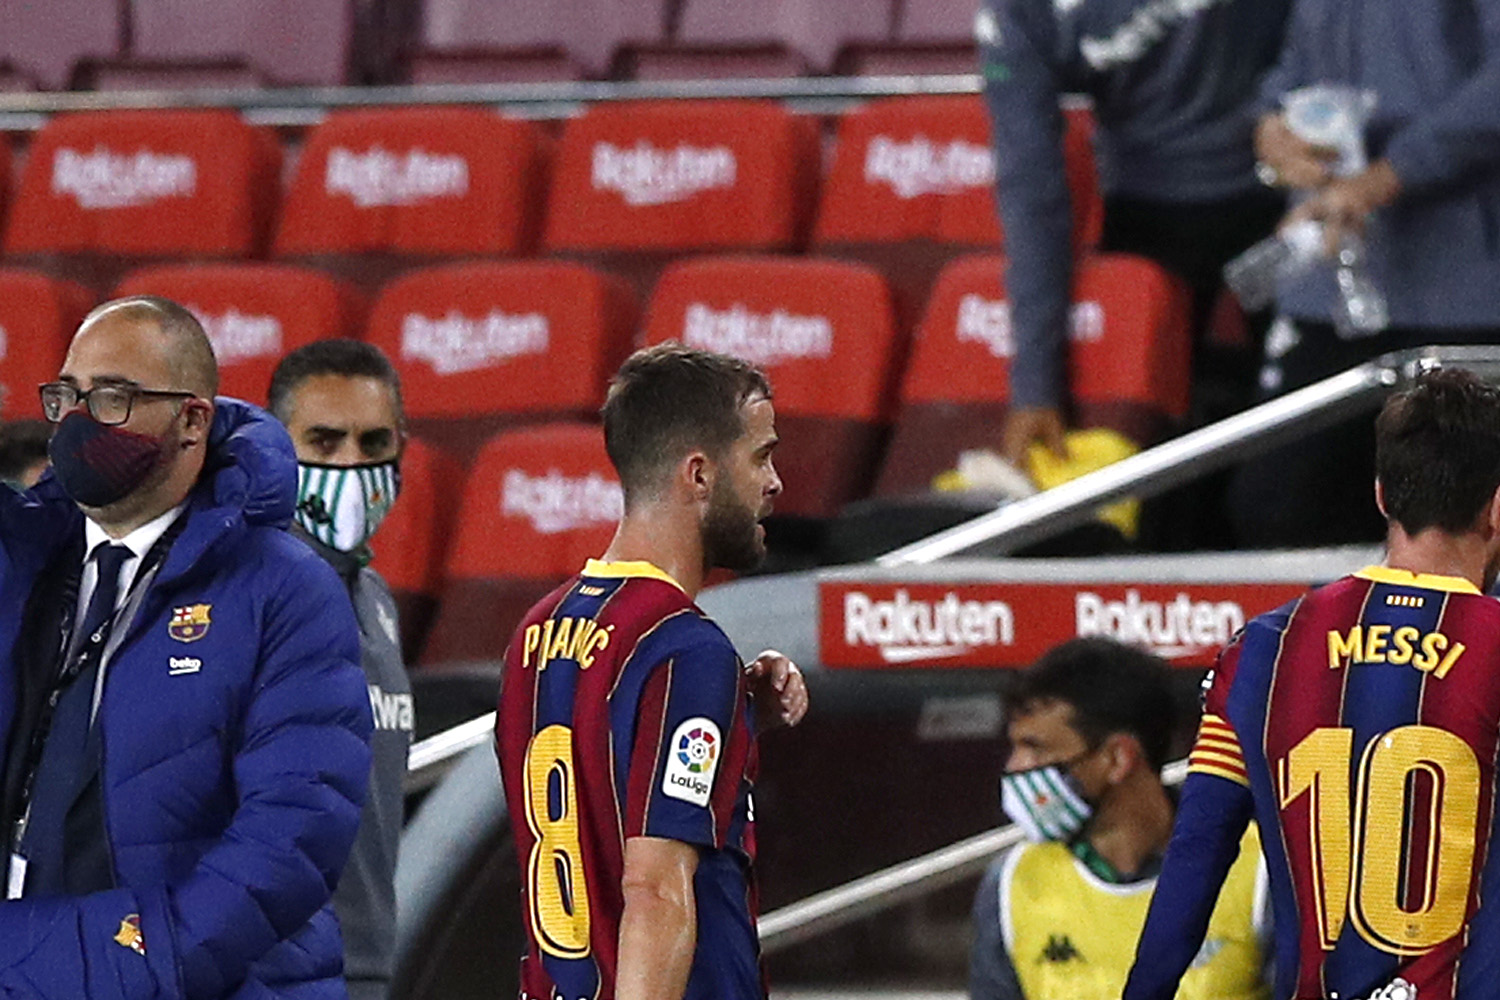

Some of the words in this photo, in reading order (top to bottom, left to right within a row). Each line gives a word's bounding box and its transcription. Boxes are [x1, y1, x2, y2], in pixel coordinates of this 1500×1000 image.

[501, 469, 623, 534] Rakute
[843, 589, 1014, 648] Rakuten
[1074, 588, 1245, 648] Rakuten
[169, 656, 202, 673] beko
[1327, 624, 1466, 681] MESSI
[523, 724, 591, 960] 8
[1278, 725, 1481, 957] 10
